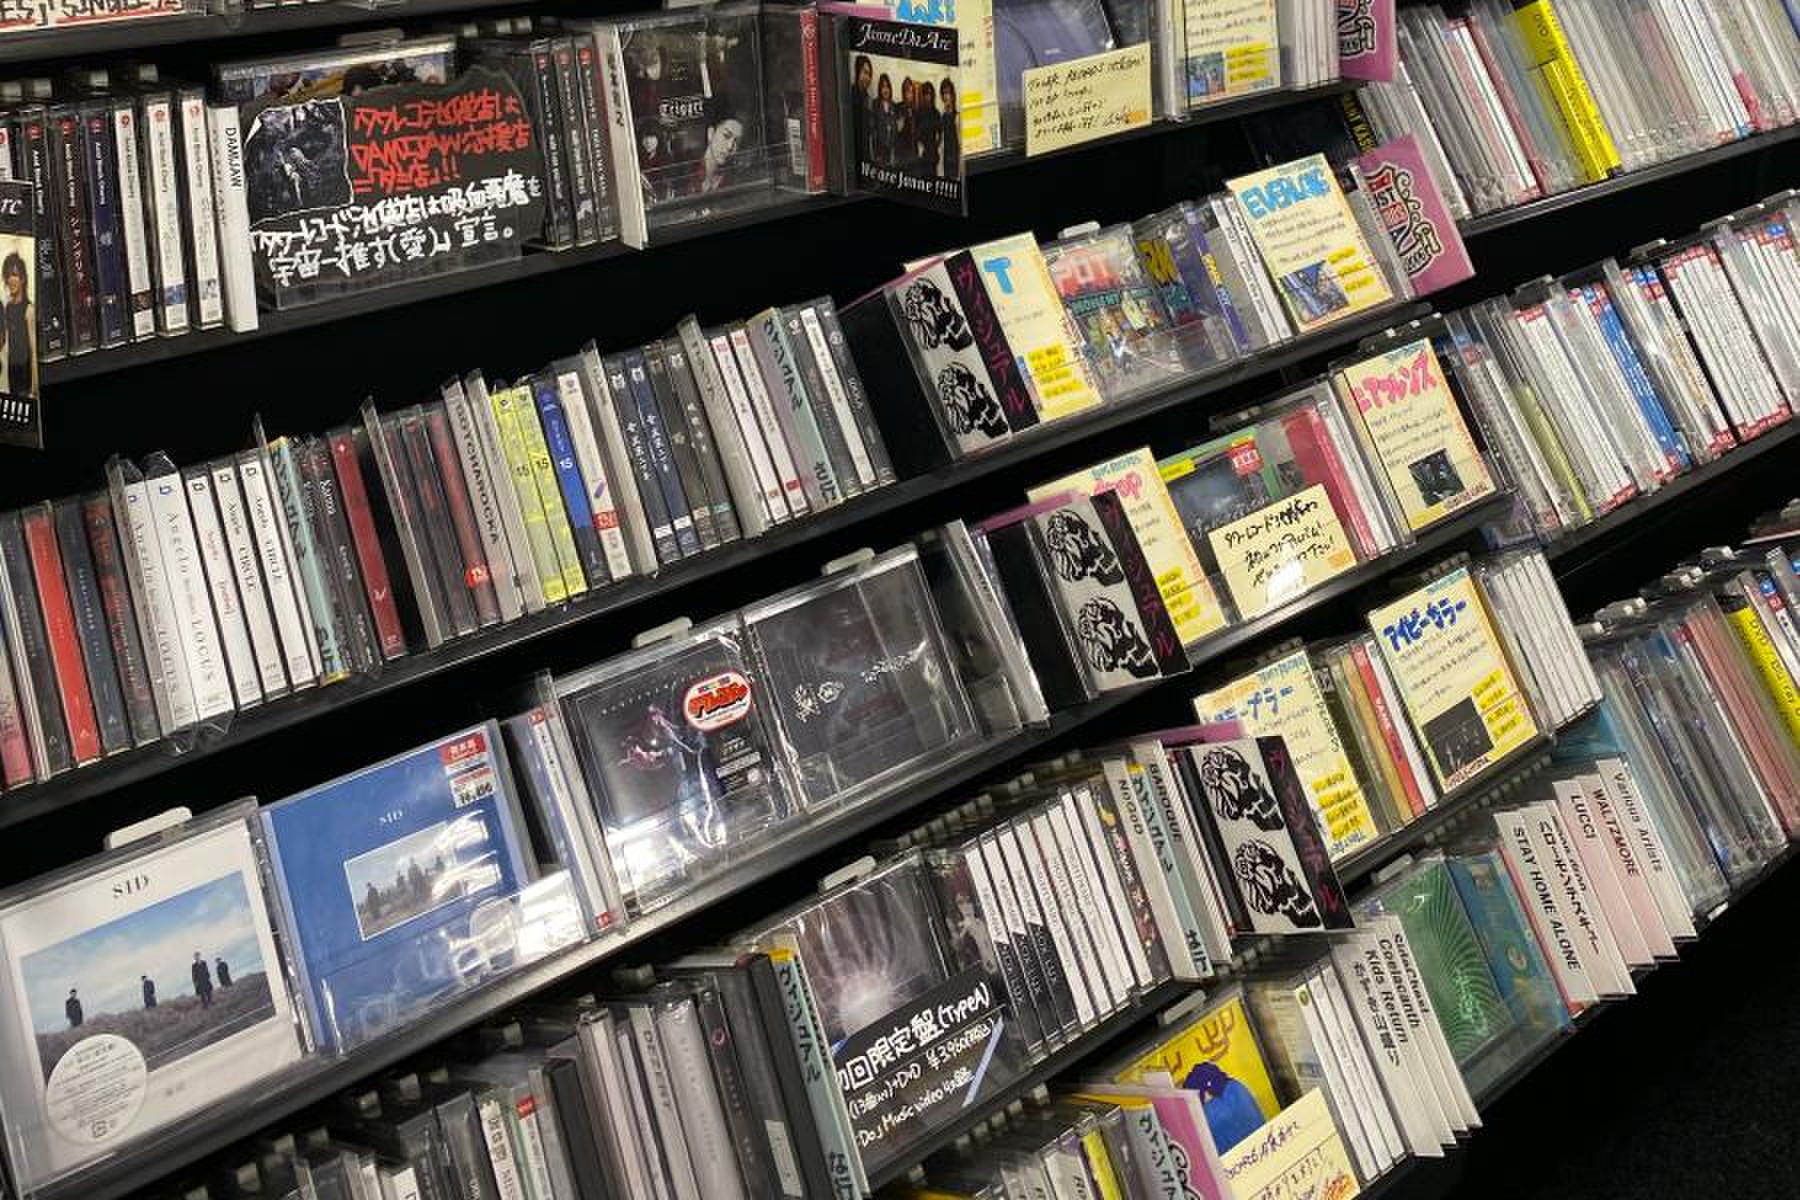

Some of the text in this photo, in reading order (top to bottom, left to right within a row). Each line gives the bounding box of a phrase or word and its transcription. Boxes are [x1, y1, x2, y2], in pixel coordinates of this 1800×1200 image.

[1149, 763, 1184, 843] BAROQUE
[1571, 795, 1597, 840] LUCCI
[1593, 788, 1641, 877] WALTZMORE
[1613, 772, 1664, 874] Various Artists
[111, 873, 151, 899] SID
[1513, 827, 1582, 971] STAY HOME ALONE
[1365, 949, 1386, 993] Kids
[1380, 990, 1409, 1043] Return
